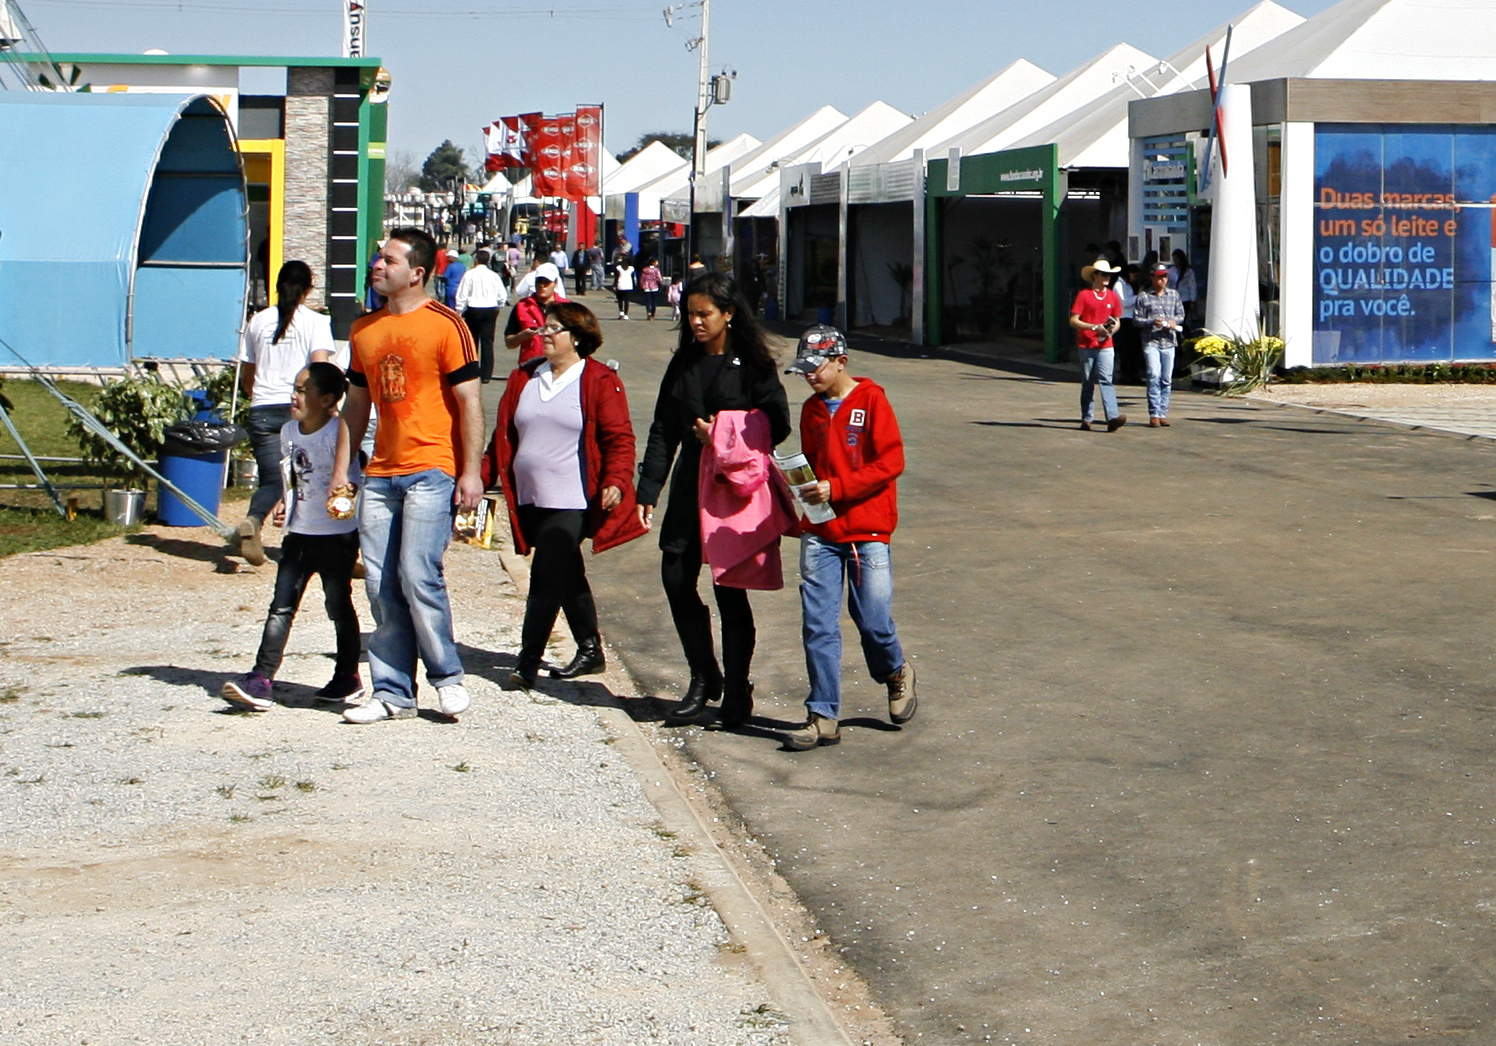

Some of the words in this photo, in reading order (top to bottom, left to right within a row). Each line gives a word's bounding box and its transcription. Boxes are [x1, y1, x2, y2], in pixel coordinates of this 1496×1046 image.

[1320, 187, 1375, 210] Duas
[1380, 192, 1461, 214] marcas,
[1320, 219, 1357, 237] um
[1360, 214, 1386, 237] só
[1391, 215, 1439, 237] leite
[1443, 219, 1457, 237] e
[1320, 246, 1334, 263] o
[1339, 242, 1403, 264] dobro
[1408, 242, 1435, 264] de
[1319, 267, 1454, 296] QUALIDADE
[1320, 299, 1355, 322] pra
[1360, 293, 1416, 316] você.
[852, 412, 863, 423] B
